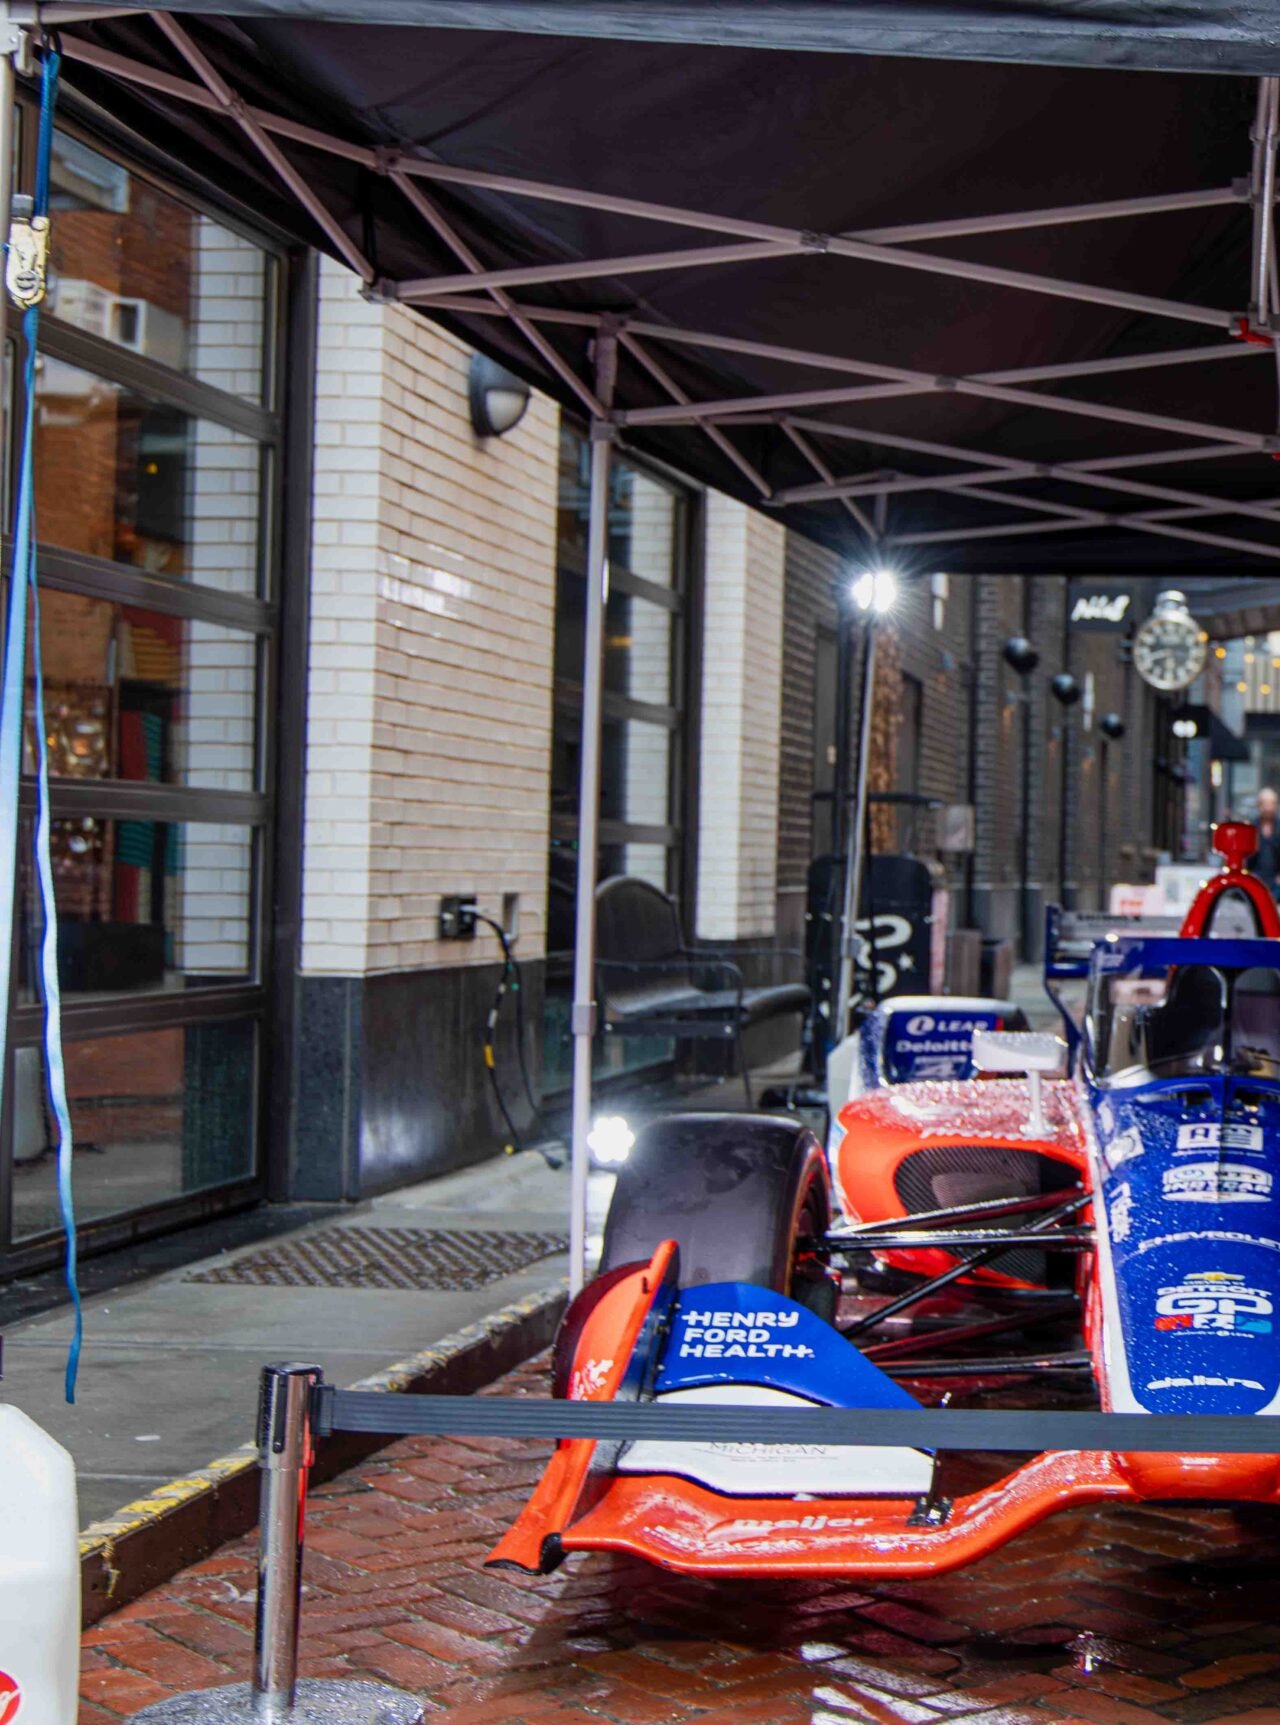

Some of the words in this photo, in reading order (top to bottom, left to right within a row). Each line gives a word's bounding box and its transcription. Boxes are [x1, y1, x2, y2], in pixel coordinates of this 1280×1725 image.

[937, 1020, 988, 1032] LEAR
[895, 1040, 973, 1053] Deloitt
[1157, 1285, 1273, 1298] DETROIT
[1156, 1292, 1273, 1315] GP
[681, 1310, 799, 1328] HENRY
[683, 1328, 771, 1343] FORD
[1146, 1374, 1266, 1391] dallara
[732, 1515, 874, 1530] meijer
